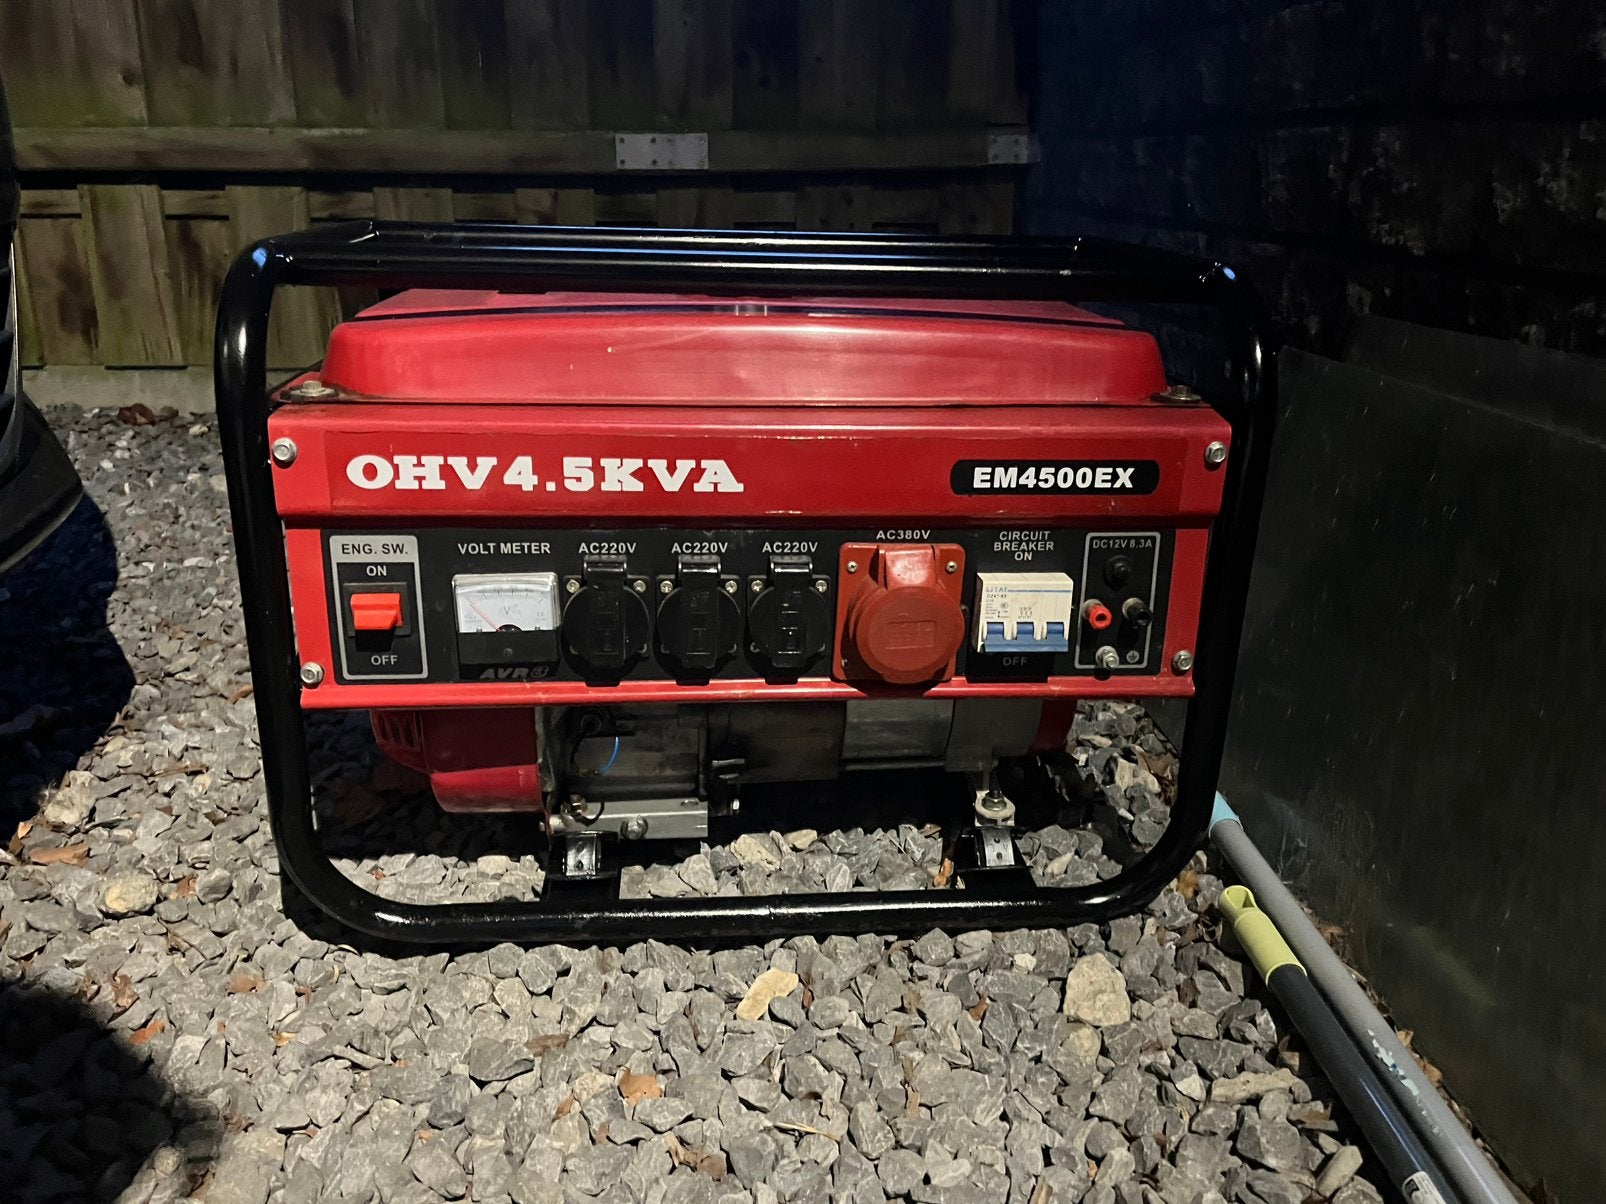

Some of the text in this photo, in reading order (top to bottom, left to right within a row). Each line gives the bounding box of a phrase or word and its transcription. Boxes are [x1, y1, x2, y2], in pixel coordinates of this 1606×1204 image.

[972, 466, 1136, 489] EM4500EX
[876, 530, 930, 541] AC380V
[999, 531, 1050, 541] CIRCUIT
[341, 543, 408, 556] ENG. SW.
[458, 543, 551, 555] VOLT METER
[579, 543, 637, 554] AC220V
[671, 542, 729, 554] AC220V
[762, 542, 818, 554] AC220V
[993, 541, 1054, 552] BREAKER
[1092, 540, 1153, 551] DC12V 8.3A
[1014, 552, 1033, 562] ON
[366, 565, 388, 577] ON
[371, 655, 399, 667] OFF
[1002, 656, 1028, 667] OFF
